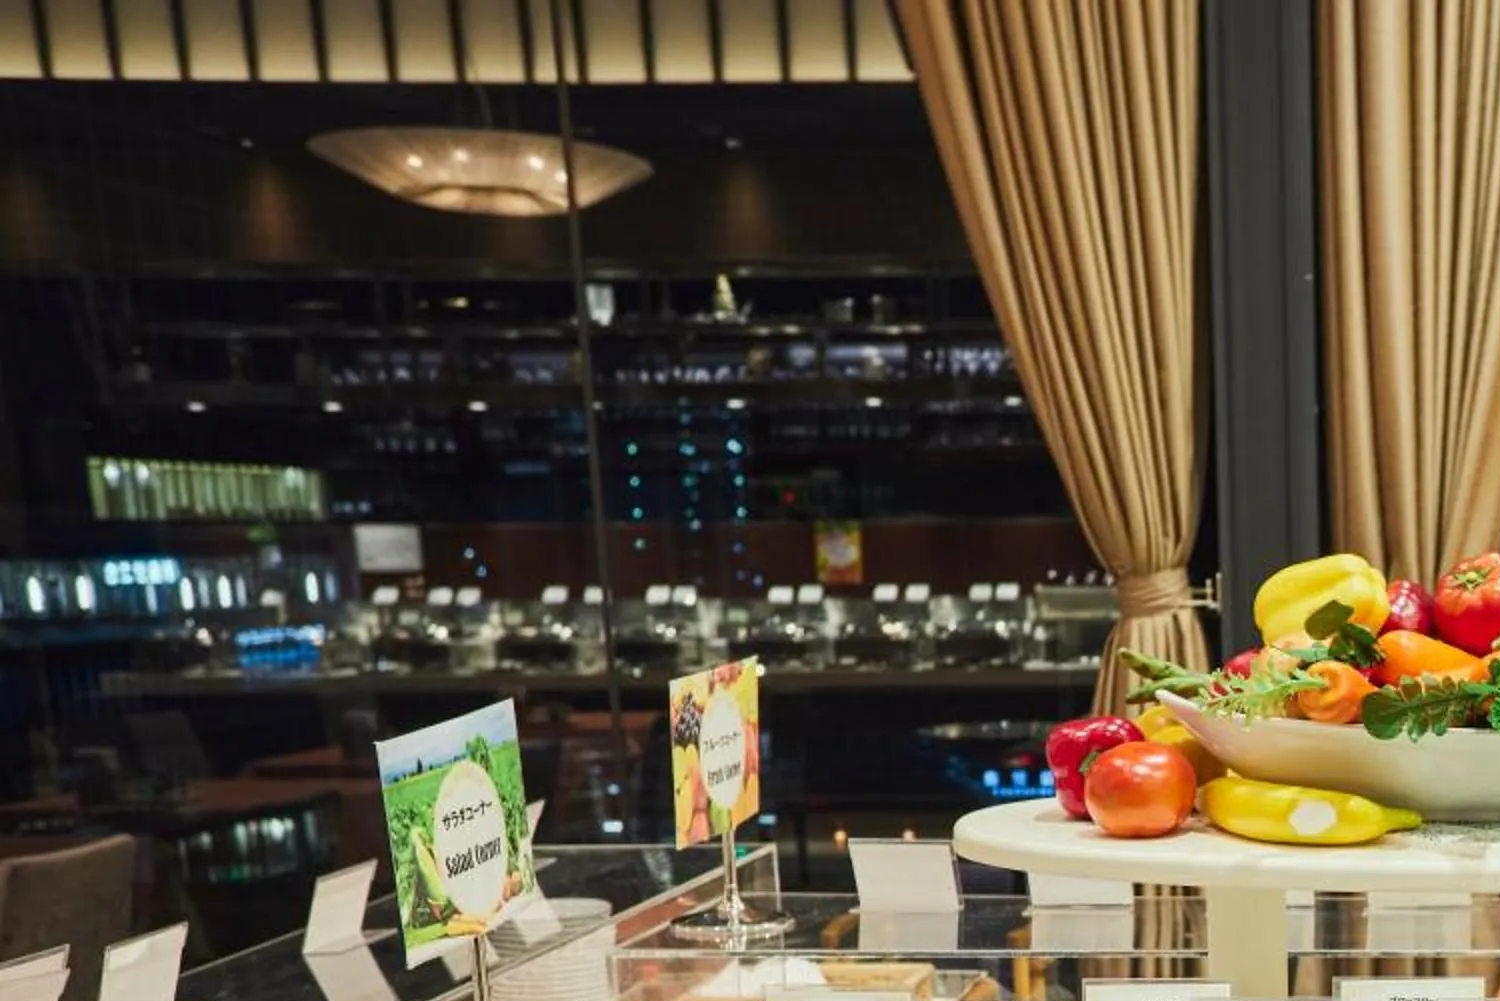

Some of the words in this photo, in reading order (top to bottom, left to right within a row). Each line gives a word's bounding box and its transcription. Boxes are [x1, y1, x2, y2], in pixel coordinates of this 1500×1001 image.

[442, 800, 493, 831] サラダコーナー
[445, 847, 475, 879] Salad
[474, 836, 501, 865] Corner
